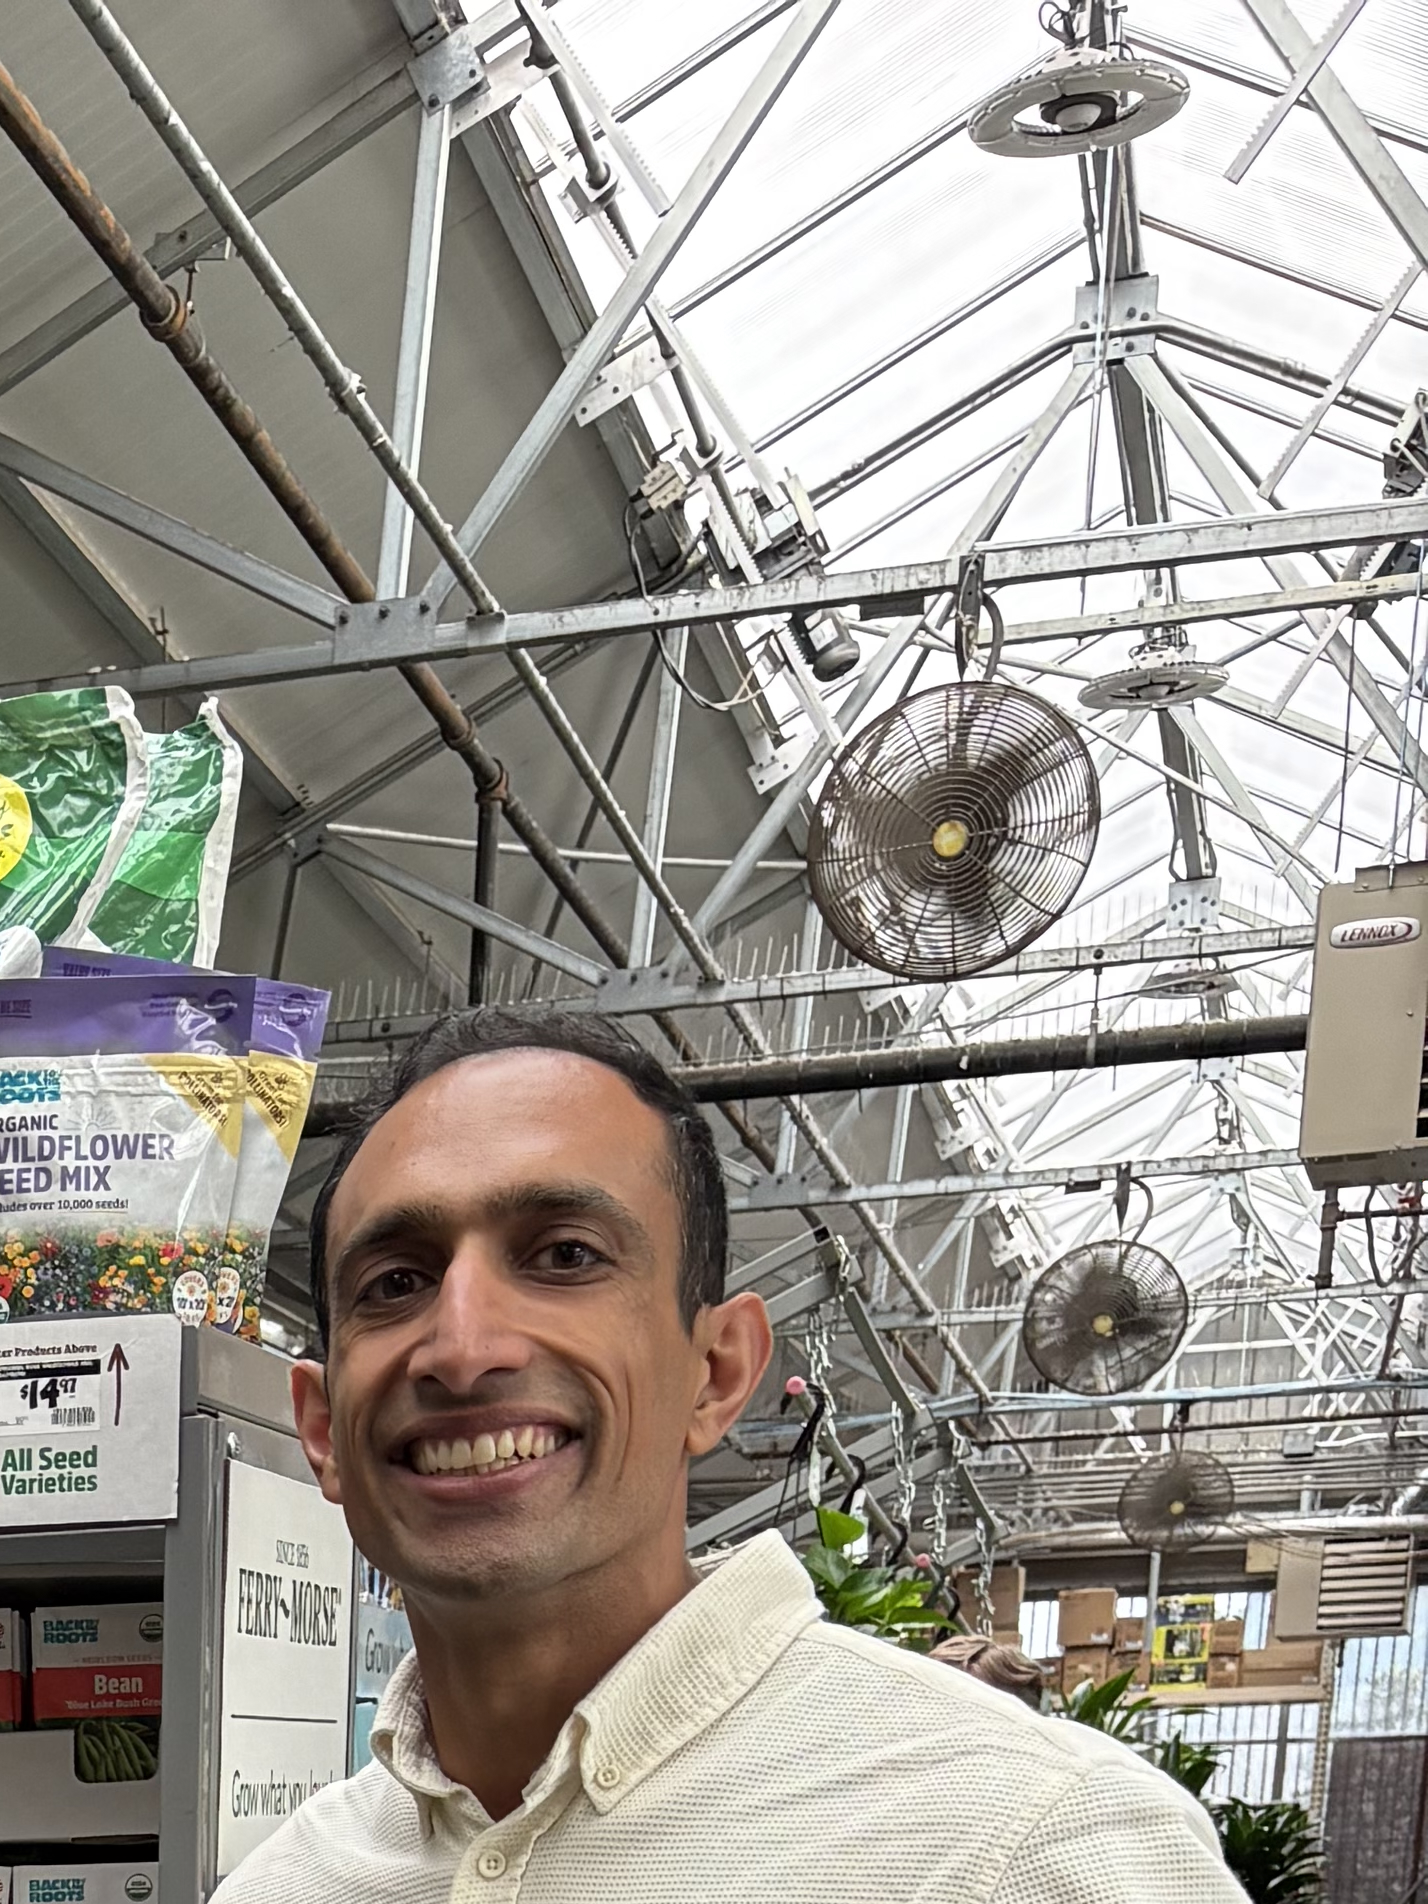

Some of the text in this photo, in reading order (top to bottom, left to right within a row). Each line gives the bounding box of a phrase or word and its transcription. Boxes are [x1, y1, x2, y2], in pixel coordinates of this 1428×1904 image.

[60, 1165, 111, 1192] MIX
[30, 1202, 55, 1210] over
[57, 1199, 93, 1211] 10,000
[96, 1199, 128, 1209] seeds!
[15, 1346, 62, 1356] Products
[64, 1344, 97, 1353] Above
[1, 1445, 97, 1472] All Seed
[1, 1472, 97, 1495] Varieties
[232, 1770, 286, 1818] Grow what
